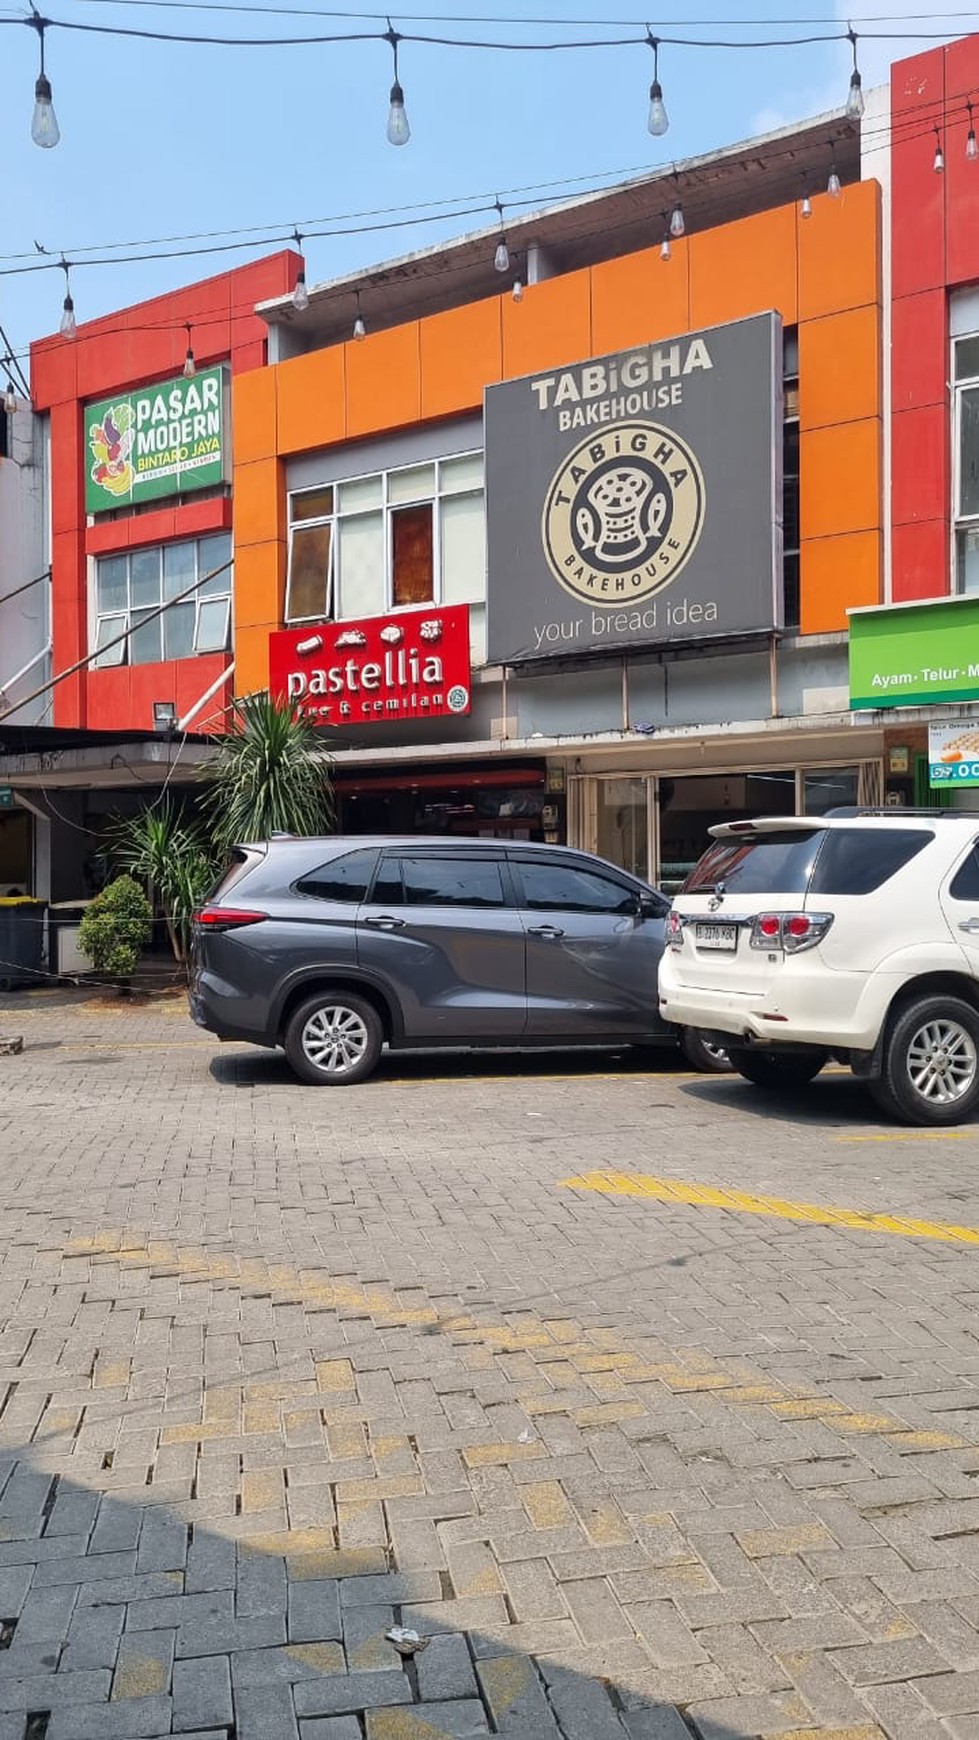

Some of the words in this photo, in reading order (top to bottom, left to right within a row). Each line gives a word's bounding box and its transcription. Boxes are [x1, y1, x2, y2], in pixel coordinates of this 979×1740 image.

[531, 338, 714, 411] TABiGHA
[137, 378, 218, 430] PASAR
[559, 382, 682, 432] BAKEHOUSE
[137, 409, 220, 456] MODERN
[138, 447, 189, 472] BINTARO
[191, 437, 220, 457] JAYA
[564, 538, 681, 592] BAKEHOUSE
[534, 619, 583, 650] your
[592, 603, 656, 636] bread
[667, 598, 718, 626] idea
[288, 647, 443, 705] pastellia
[871, 673, 912, 688] Ayam
[921, 667, 959, 682] Telur
[362, 692, 443, 713] cemilan
